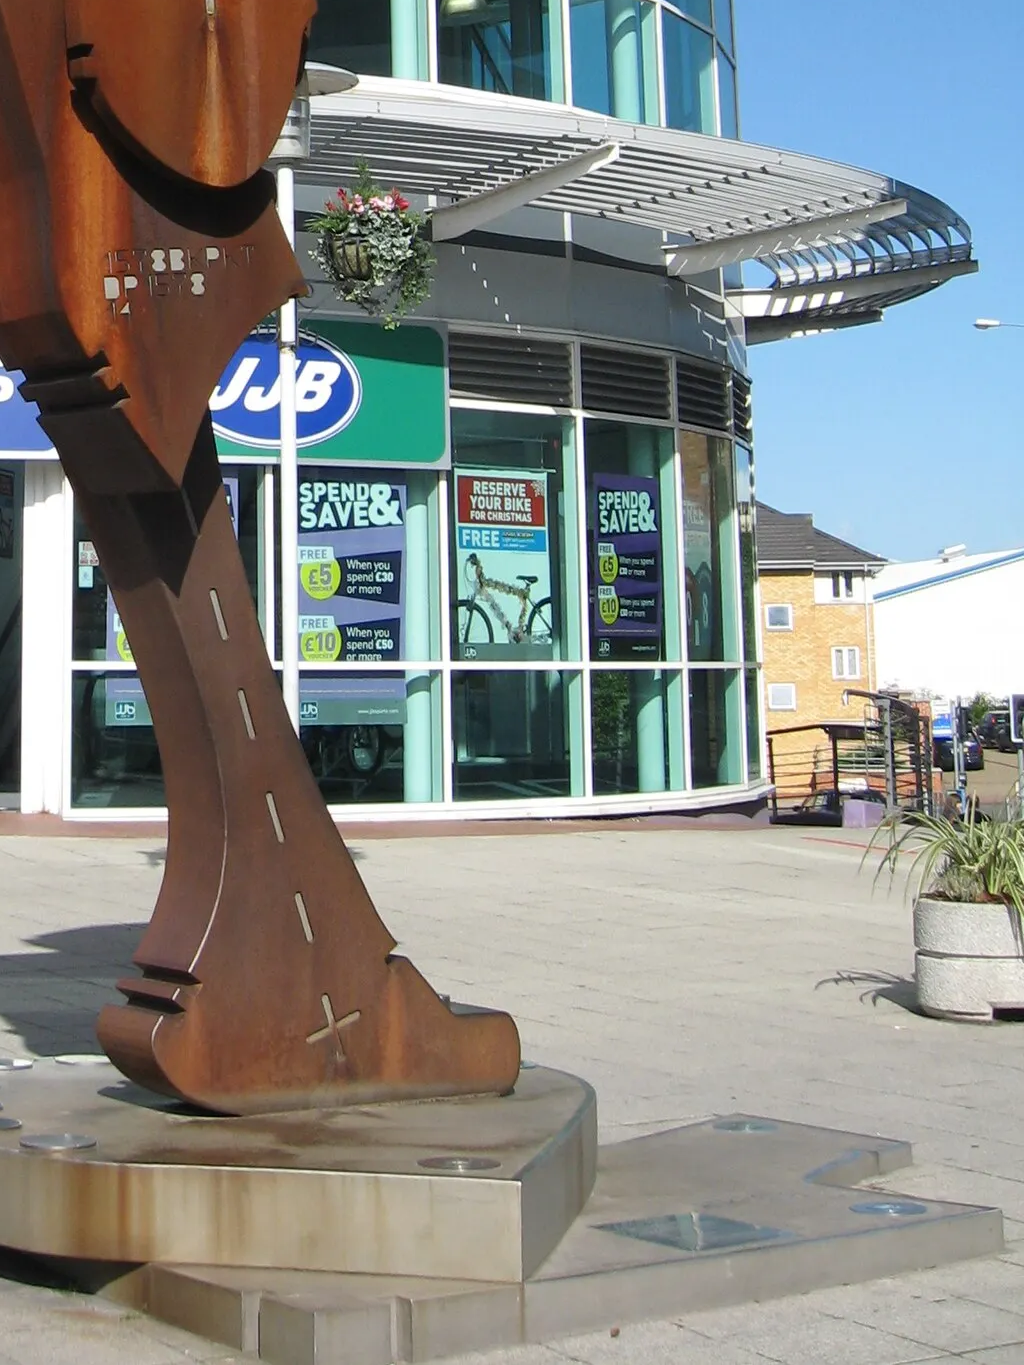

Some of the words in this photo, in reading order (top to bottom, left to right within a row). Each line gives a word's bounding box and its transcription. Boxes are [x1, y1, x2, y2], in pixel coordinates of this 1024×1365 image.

[208, 357, 342, 413] JJB
[473, 480, 527, 497] RESERVE
[299, 481, 370, 503] SPEND
[367, 481, 404, 526] &
[469, 494, 502, 511] YOUR
[504, 497, 532, 512] BIKE
[598, 491, 639, 510] SPEND
[638, 491, 658, 532] &
[299, 500, 370, 529] SAVE
[470, 510, 486, 521] FOR
[487, 511, 533, 523] CHRISTMAS
[600, 509, 639, 533] SAVE
[462, 528, 501, 547] FREE
[300, 549, 328, 560] FREE
[346, 558, 373, 570] When
[373, 560, 390, 572] you
[308, 563, 333, 585] £5
[346, 572, 374, 584] spend
[346, 585, 357, 595] or
[358, 585, 382, 595] more
[301, 617, 329, 629] FREE
[306, 632, 336, 652] £10
[346, 627, 373, 638] When
[373, 629, 390, 640] you
[346, 639, 374, 651] spend
[346, 653, 356, 661] or
[358, 652, 382, 661] more
